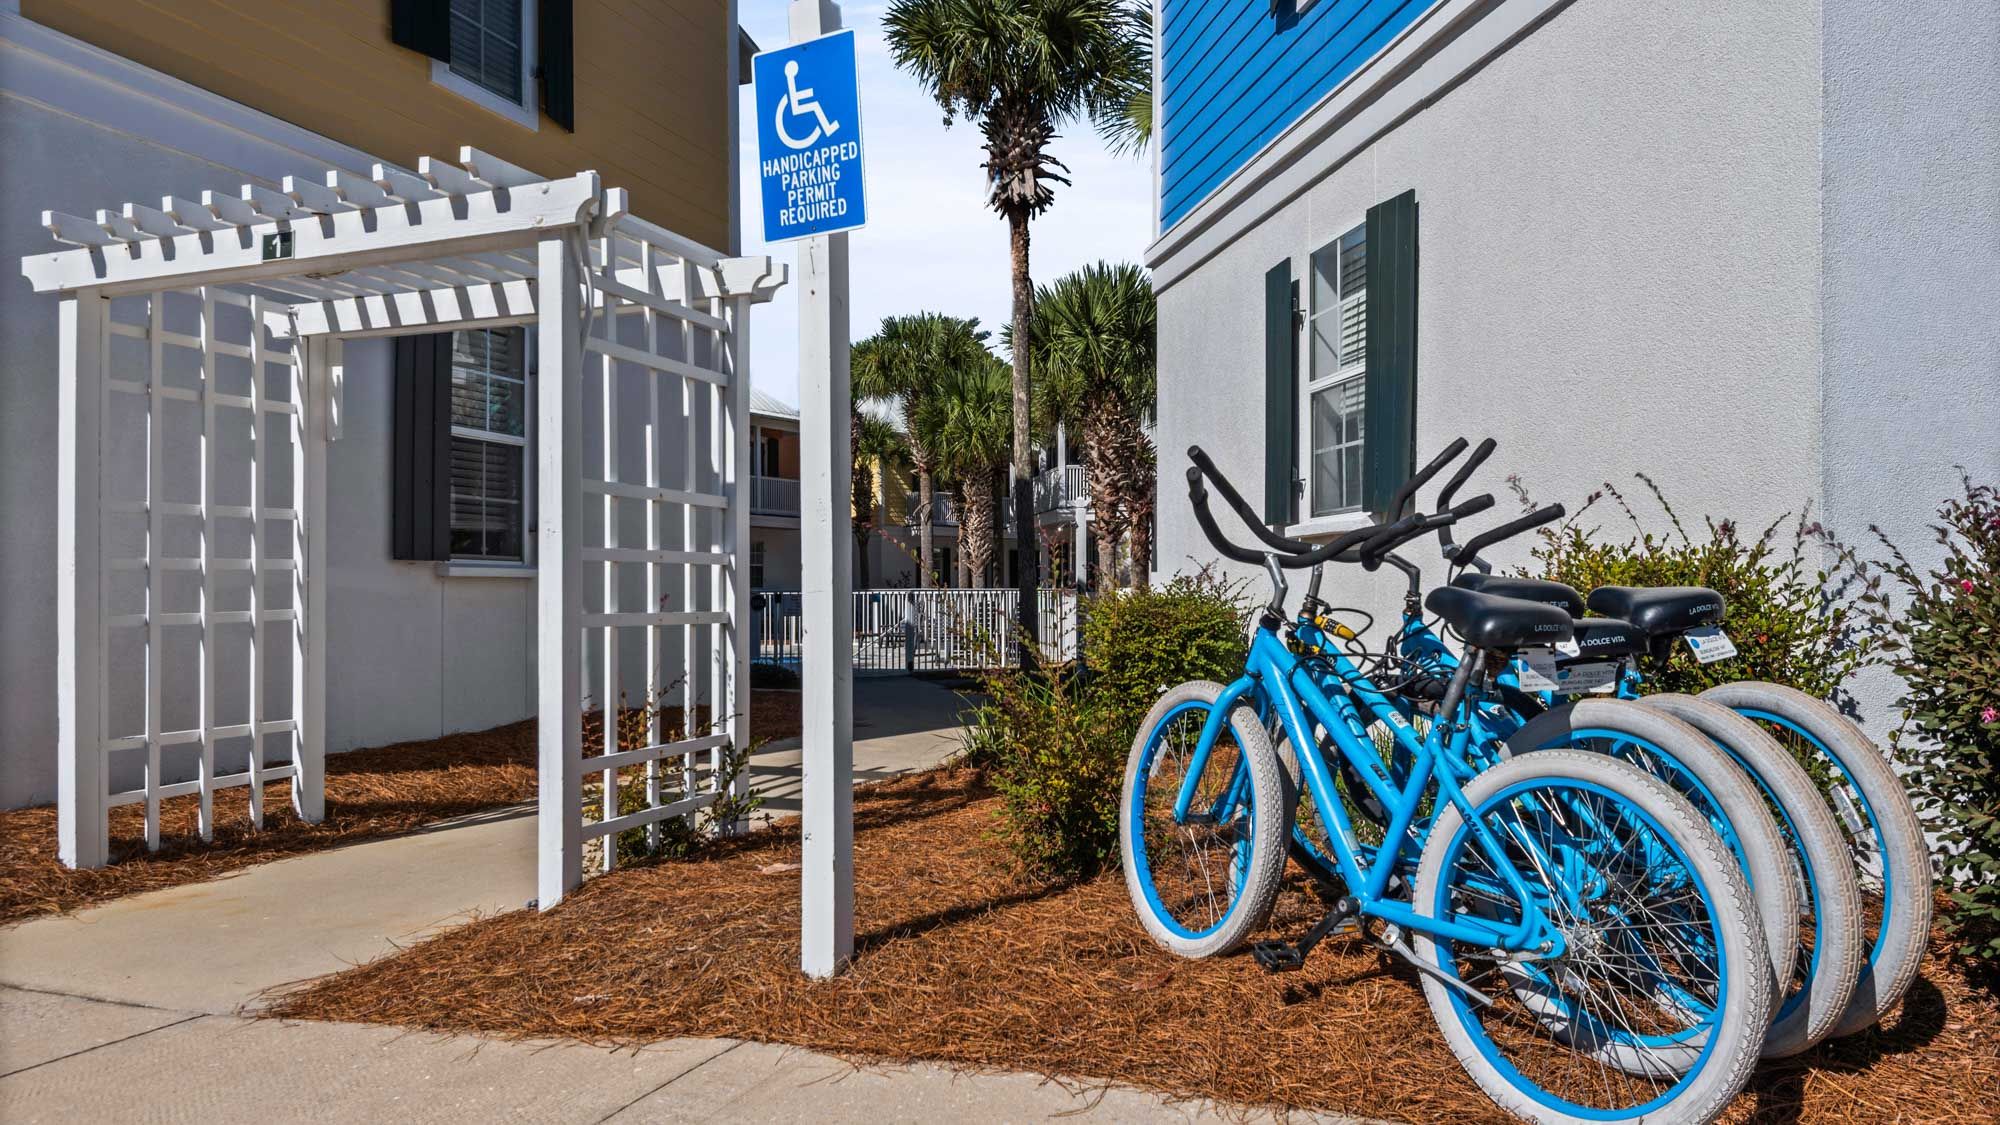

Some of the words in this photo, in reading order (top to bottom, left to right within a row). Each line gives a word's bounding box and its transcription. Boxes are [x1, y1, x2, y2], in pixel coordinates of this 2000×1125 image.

[763, 141, 858, 178] HANDICAPPED
[781, 163, 840, 191] PARKING
[788, 181, 837, 206] PERMIT
[780, 198, 847, 227] REQUIRED
[271, 234, 282, 258] 1
[1534, 624, 1543, 632] LA
[1587, 637, 1611, 646] DOLCE
[1611, 635, 1625, 643] VITA
